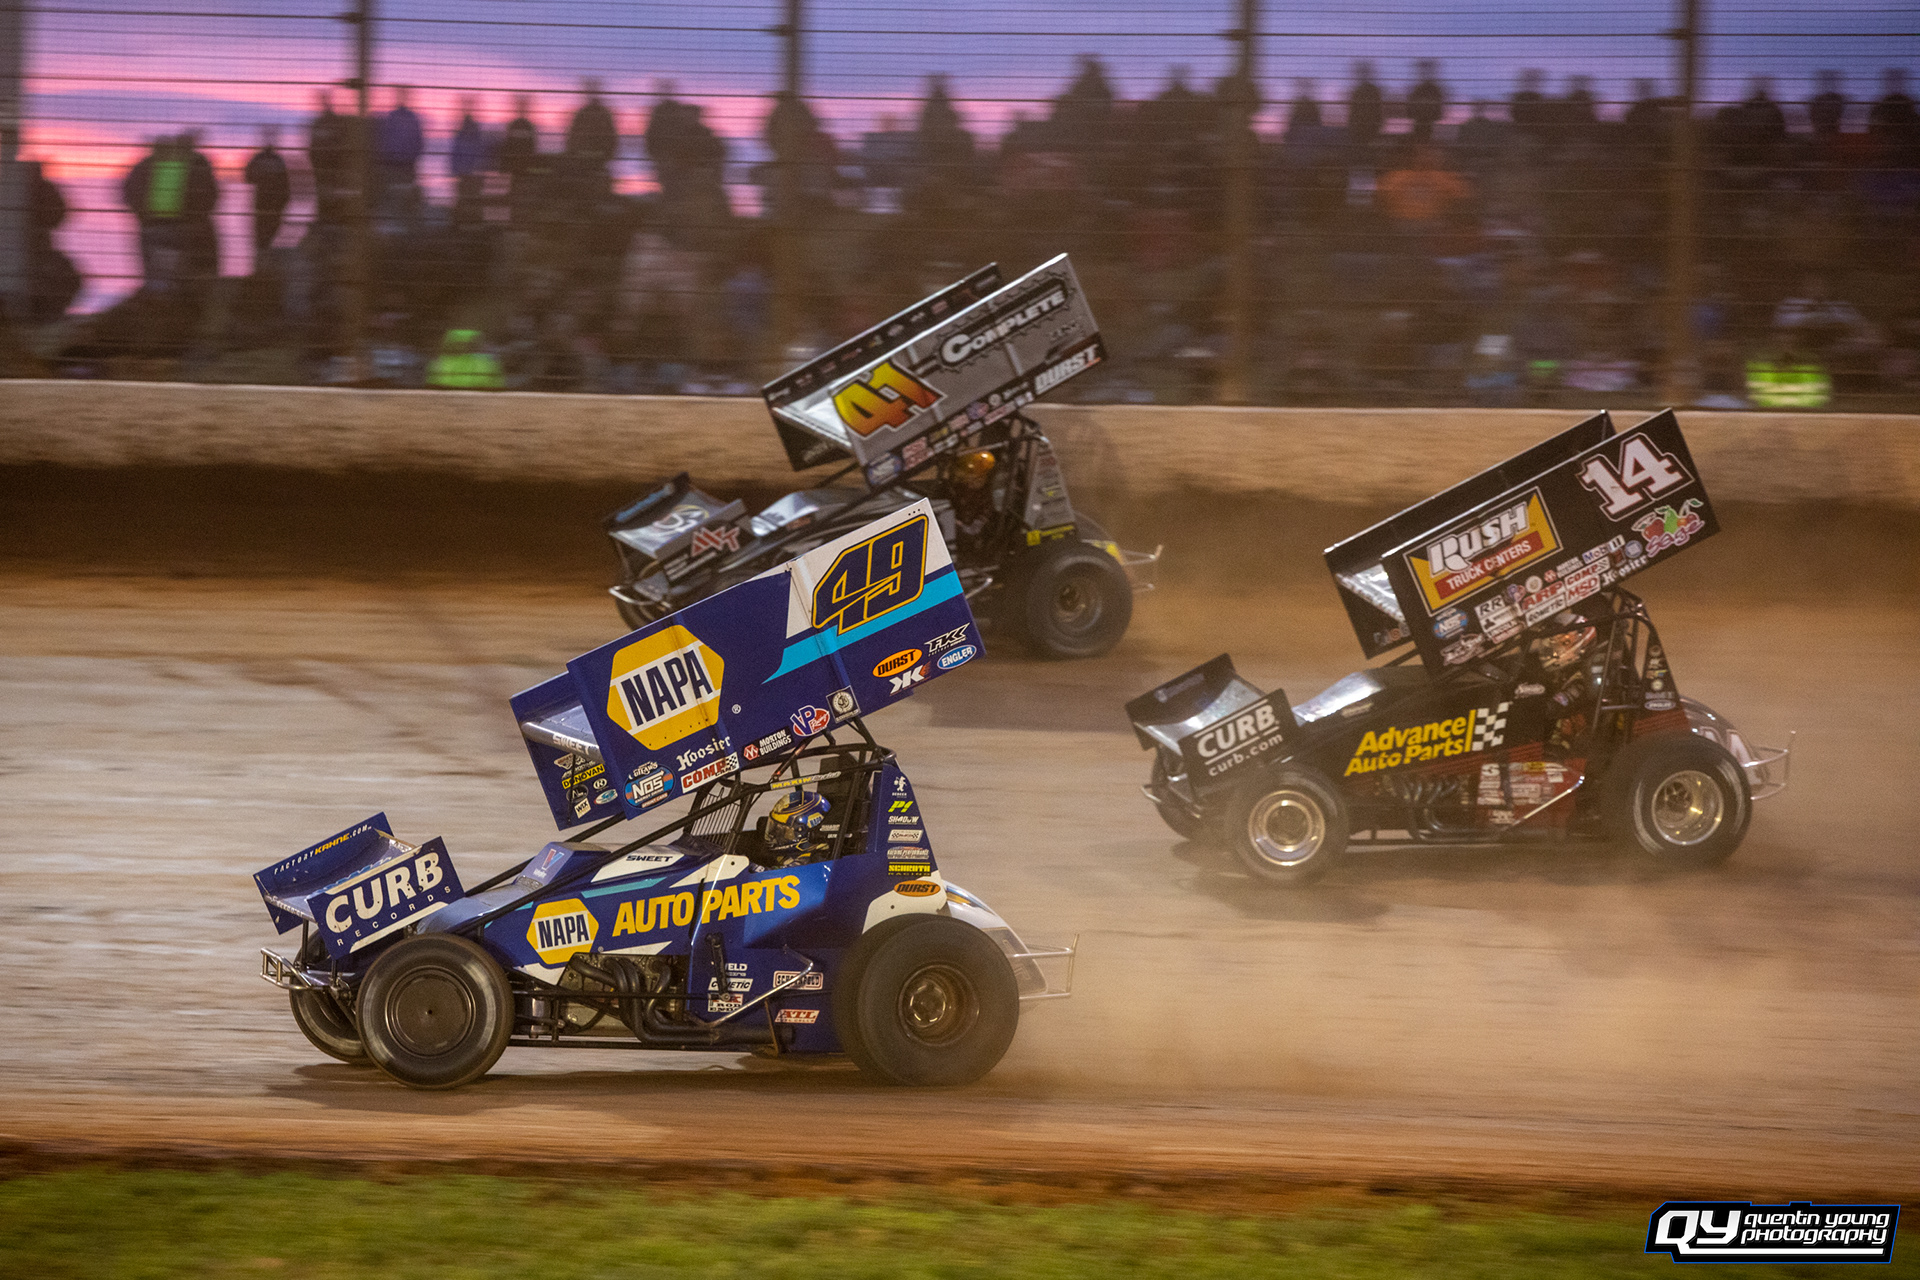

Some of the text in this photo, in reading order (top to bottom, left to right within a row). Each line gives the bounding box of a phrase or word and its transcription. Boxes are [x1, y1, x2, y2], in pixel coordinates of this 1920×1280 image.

[833, 361, 941, 438] 41
[1581, 437, 1684, 516] 14
[1430, 504, 1528, 575] RUSH
[812, 514, 929, 635] 49
[1446, 562, 1484, 590] TRUCK
[1484, 540, 1532, 571] CENTERS
[877, 649, 917, 676] DURST
[941, 647, 973, 668] ENGLER
[621, 650, 713, 727] NAPA
[759, 729, 786, 748] MORTON
[790, 705, 816, 735] VP
[1197, 704, 1276, 758] CURB
[1355, 716, 1467, 756] Advance
[676, 736, 731, 772] Hoosier
[760, 735, 792, 756] BUILDINGS
[1208, 733, 1284, 776] curb.com
[1344, 738, 1464, 777] Auto Parts
[563, 765, 604, 787] DNOVAN
[632, 774, 664, 800] NOS
[683, 759, 726, 788] COMP
[325, 852, 444, 934] CURB
[612, 875, 801, 937] AUTO PARTS
[896, 883, 939, 893] DURST
[337, 886, 451, 946] RECORDS
[538, 913, 590, 949] NAPA
